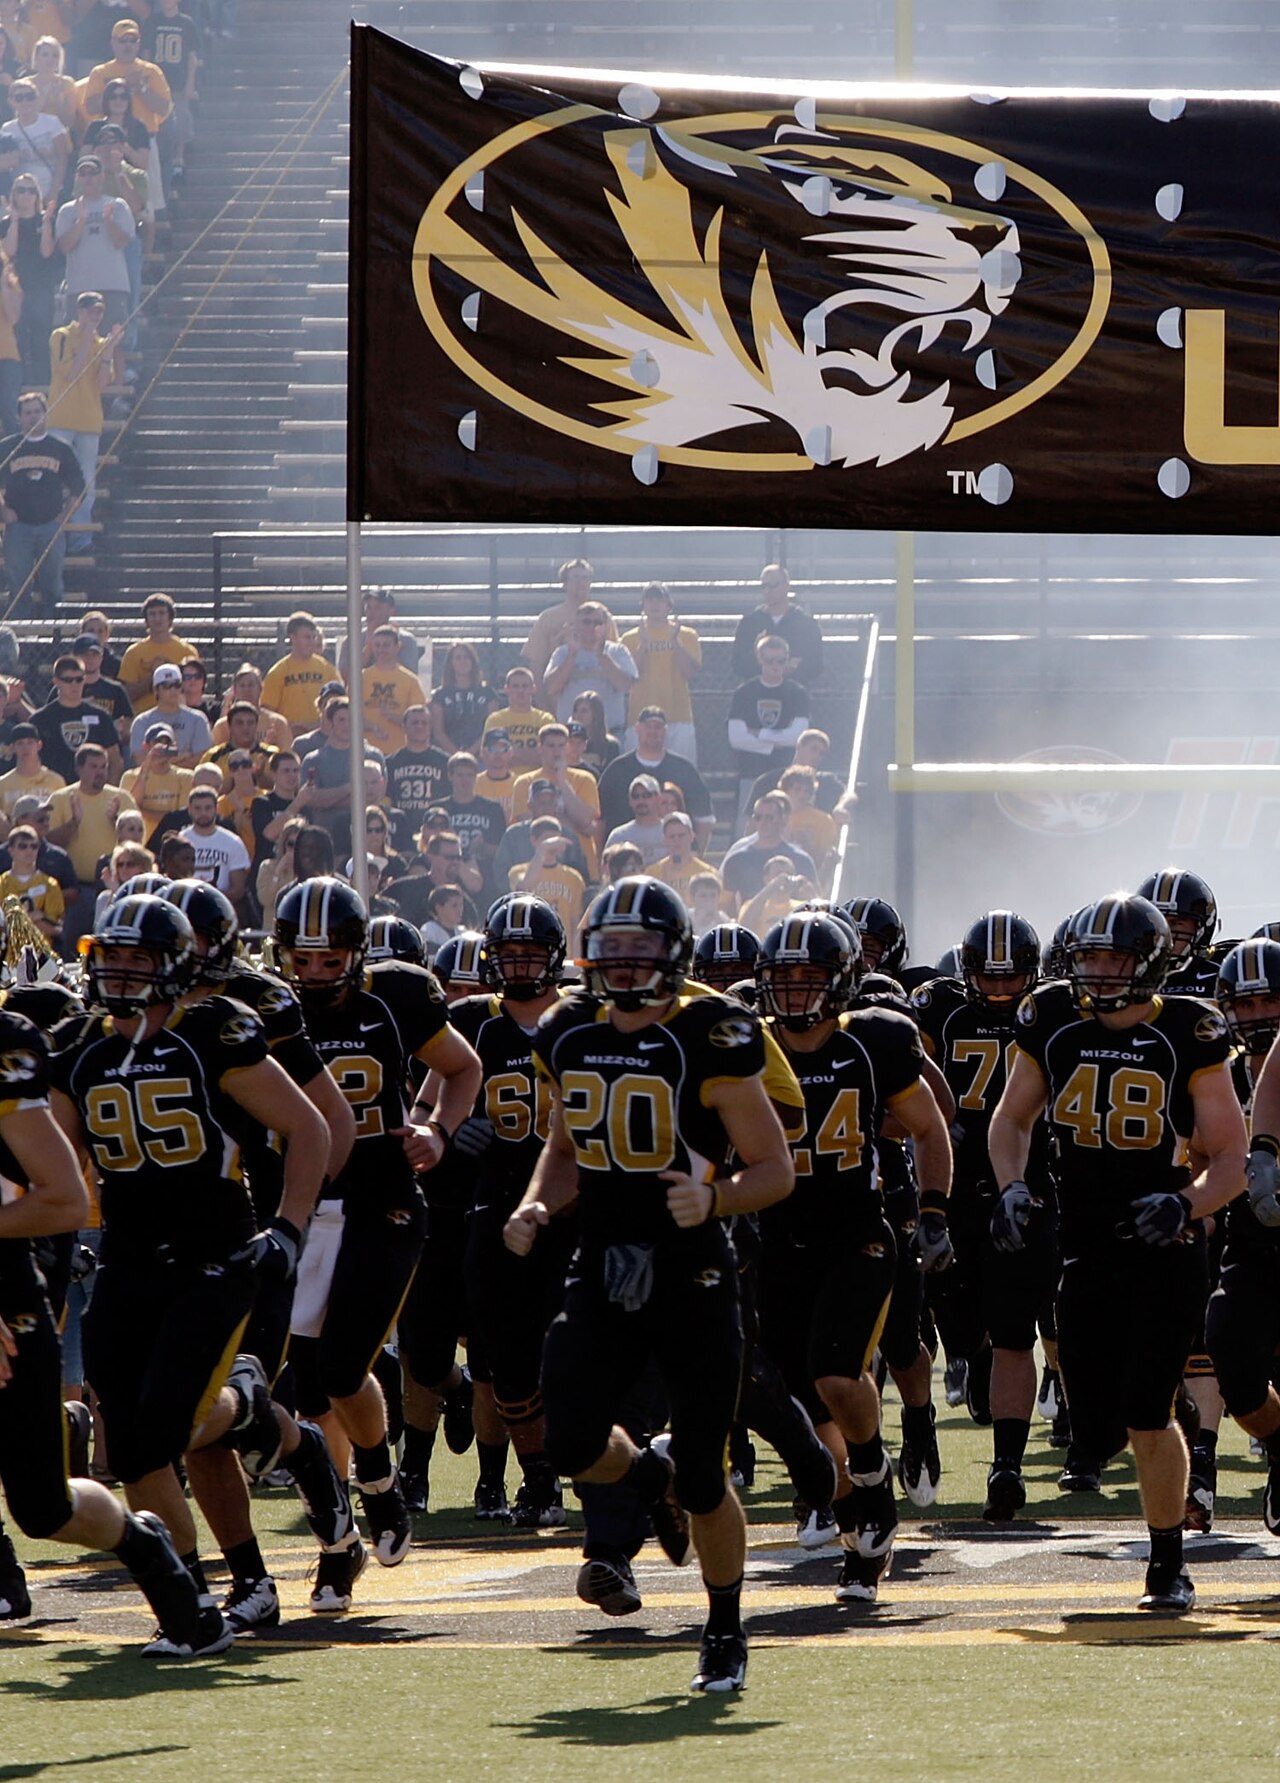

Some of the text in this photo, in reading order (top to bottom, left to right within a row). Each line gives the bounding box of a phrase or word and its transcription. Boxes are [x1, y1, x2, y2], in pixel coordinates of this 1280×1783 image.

[155, 33, 183, 64] 10
[393, 764, 442, 781] MIZZOU
[400, 779, 433, 799] 331
[450, 813, 490, 829] IZZOU
[195, 847, 229, 865] ZZOU
[1161, 985, 1206, 994] IZZOU
[314, 1040, 366, 1052] IZZOU
[506, 1055, 532, 1068] MIZ
[583, 1054, 650, 1068] MIZZOU
[1080, 1049, 1145, 1062] MIZZOU
[104, 1063, 167, 1078] MZZOU
[952, 1038, 1017, 1111] 7
[1053, 1062, 1166, 1151] 48
[85, 1077, 208, 1173] 95
[560, 1070, 677, 1173] 20
